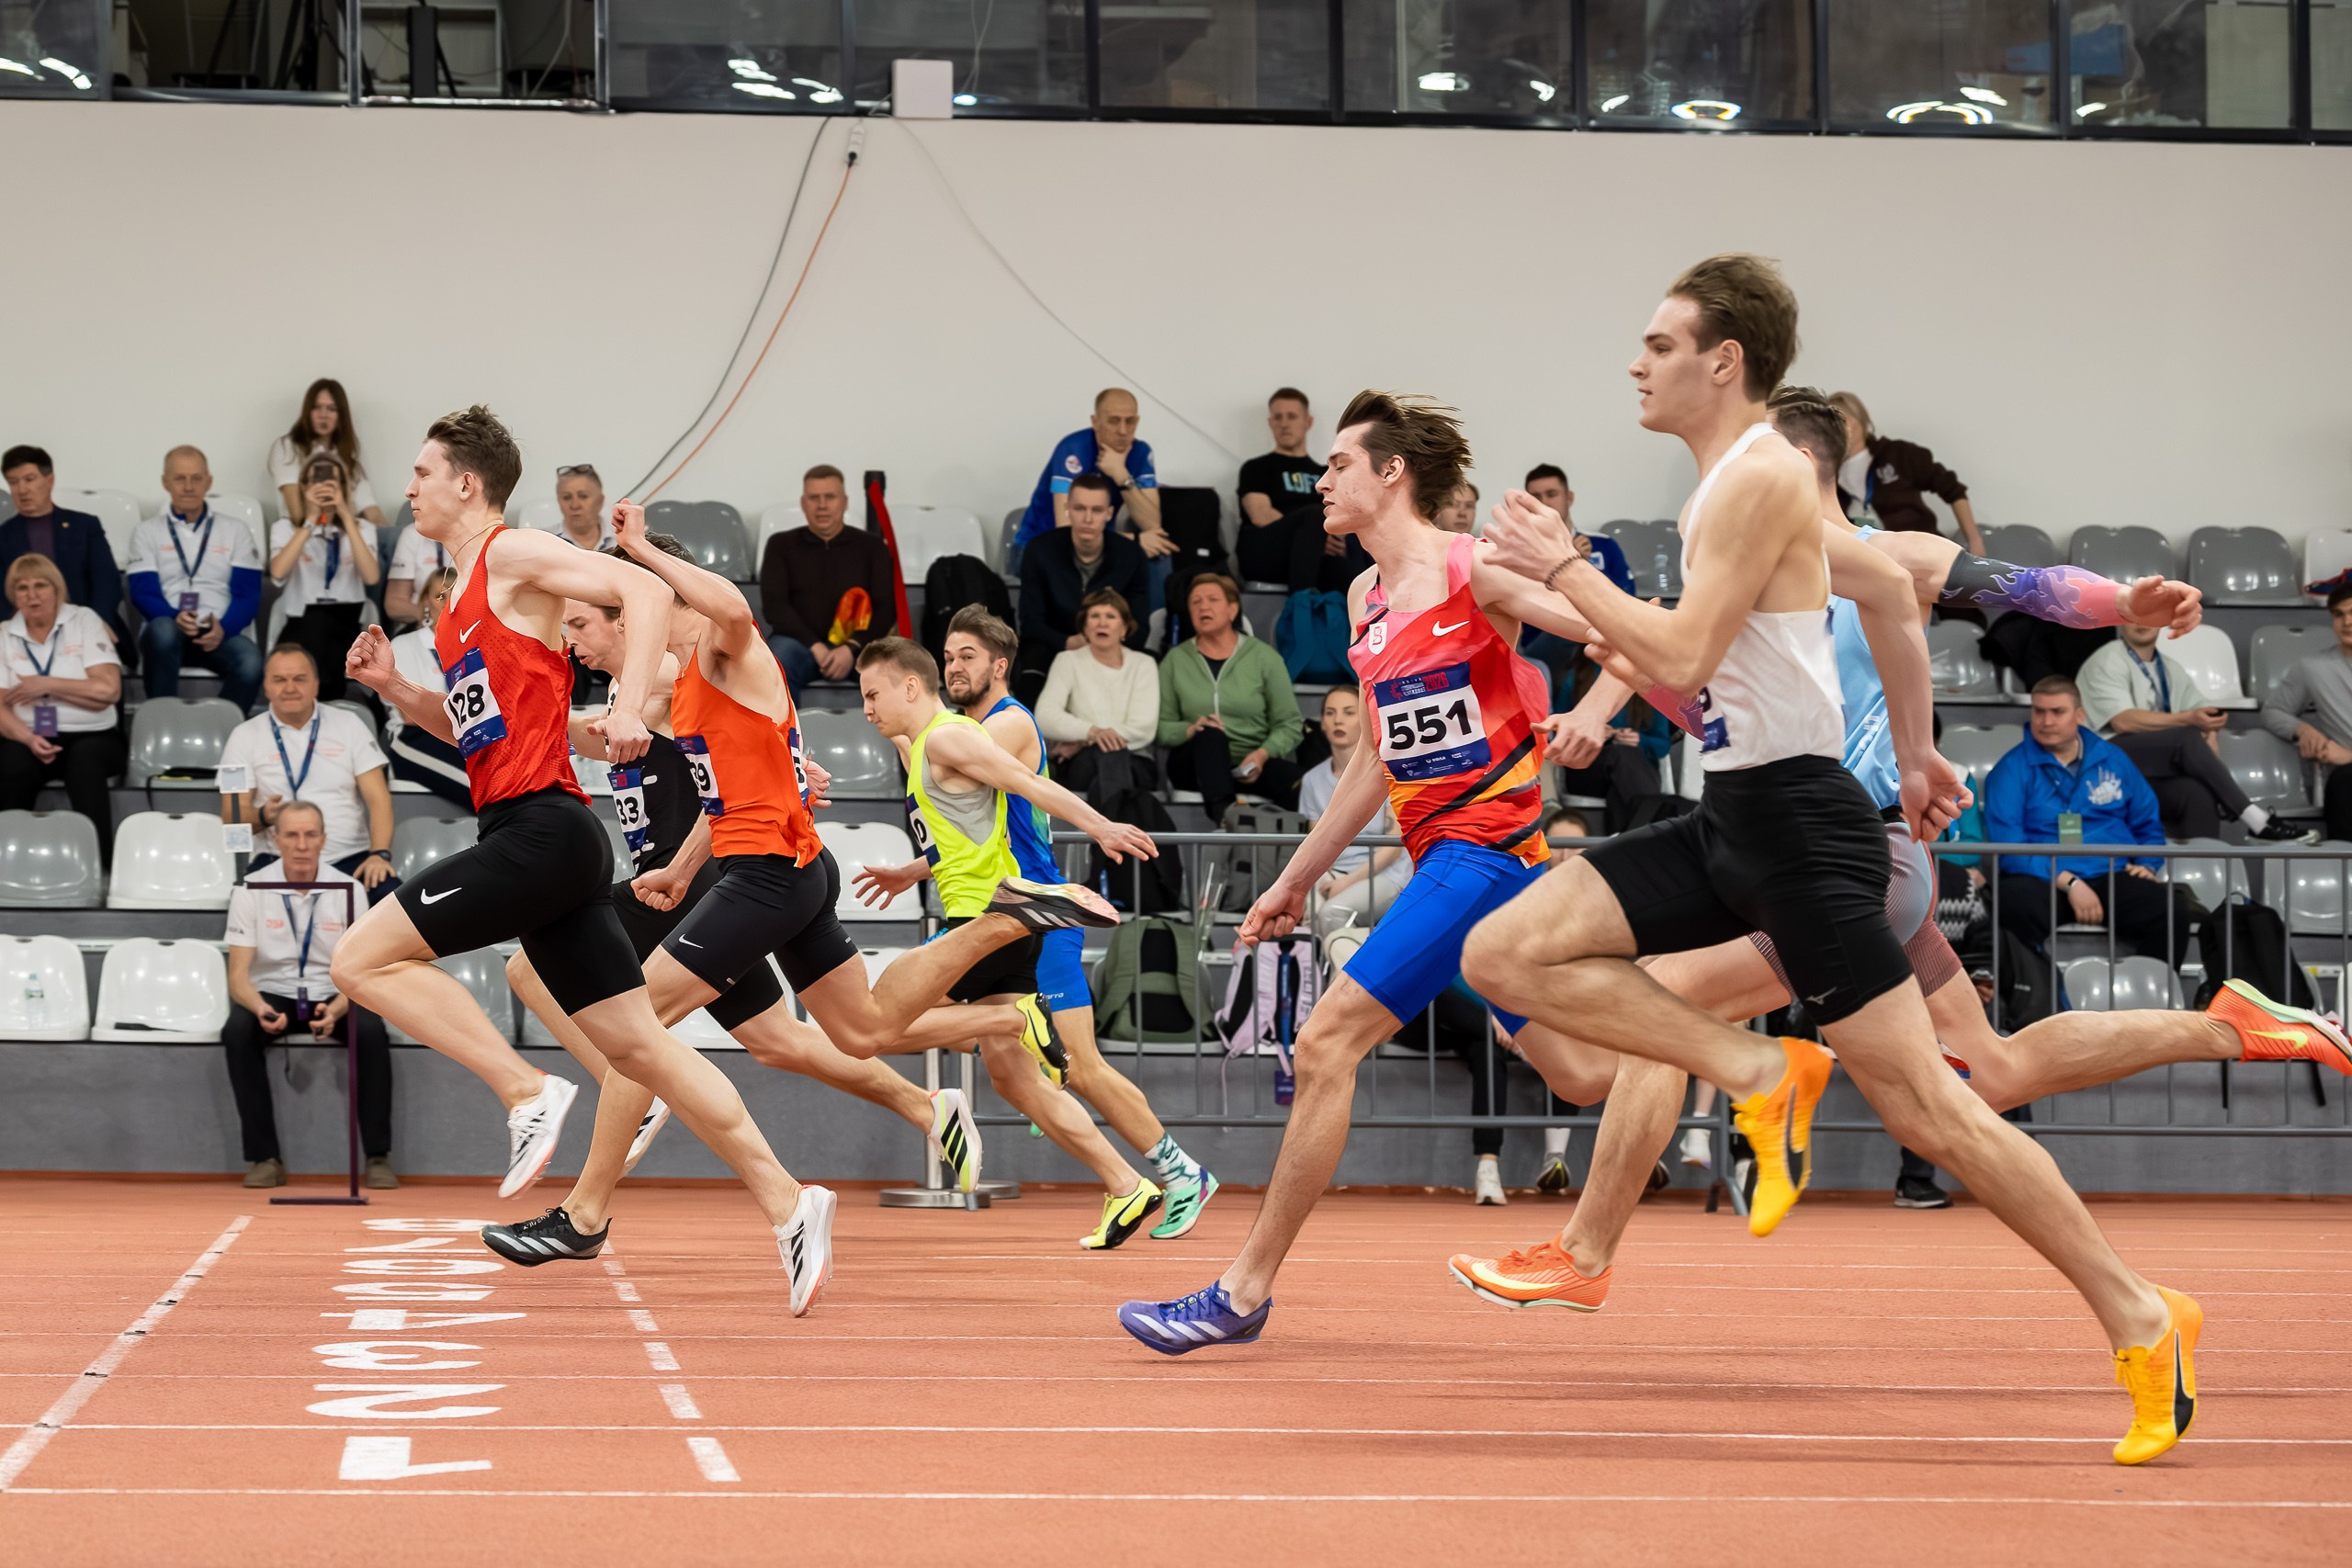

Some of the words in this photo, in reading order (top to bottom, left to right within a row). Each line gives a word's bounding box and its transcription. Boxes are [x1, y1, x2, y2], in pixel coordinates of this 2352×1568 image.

[1387, 699, 1472, 750] 551
[361, 1218, 499, 1232] 8
[344, 1237, 488, 1253] 7
[340, 1258, 505, 1275] 6
[331, 1282, 498, 1301] 5
[320, 1309, 527, 1330] 4
[311, 1341, 485, 1371] 3
[305, 1384, 507, 1419] 2
[338, 1437, 492, 1481] 1
